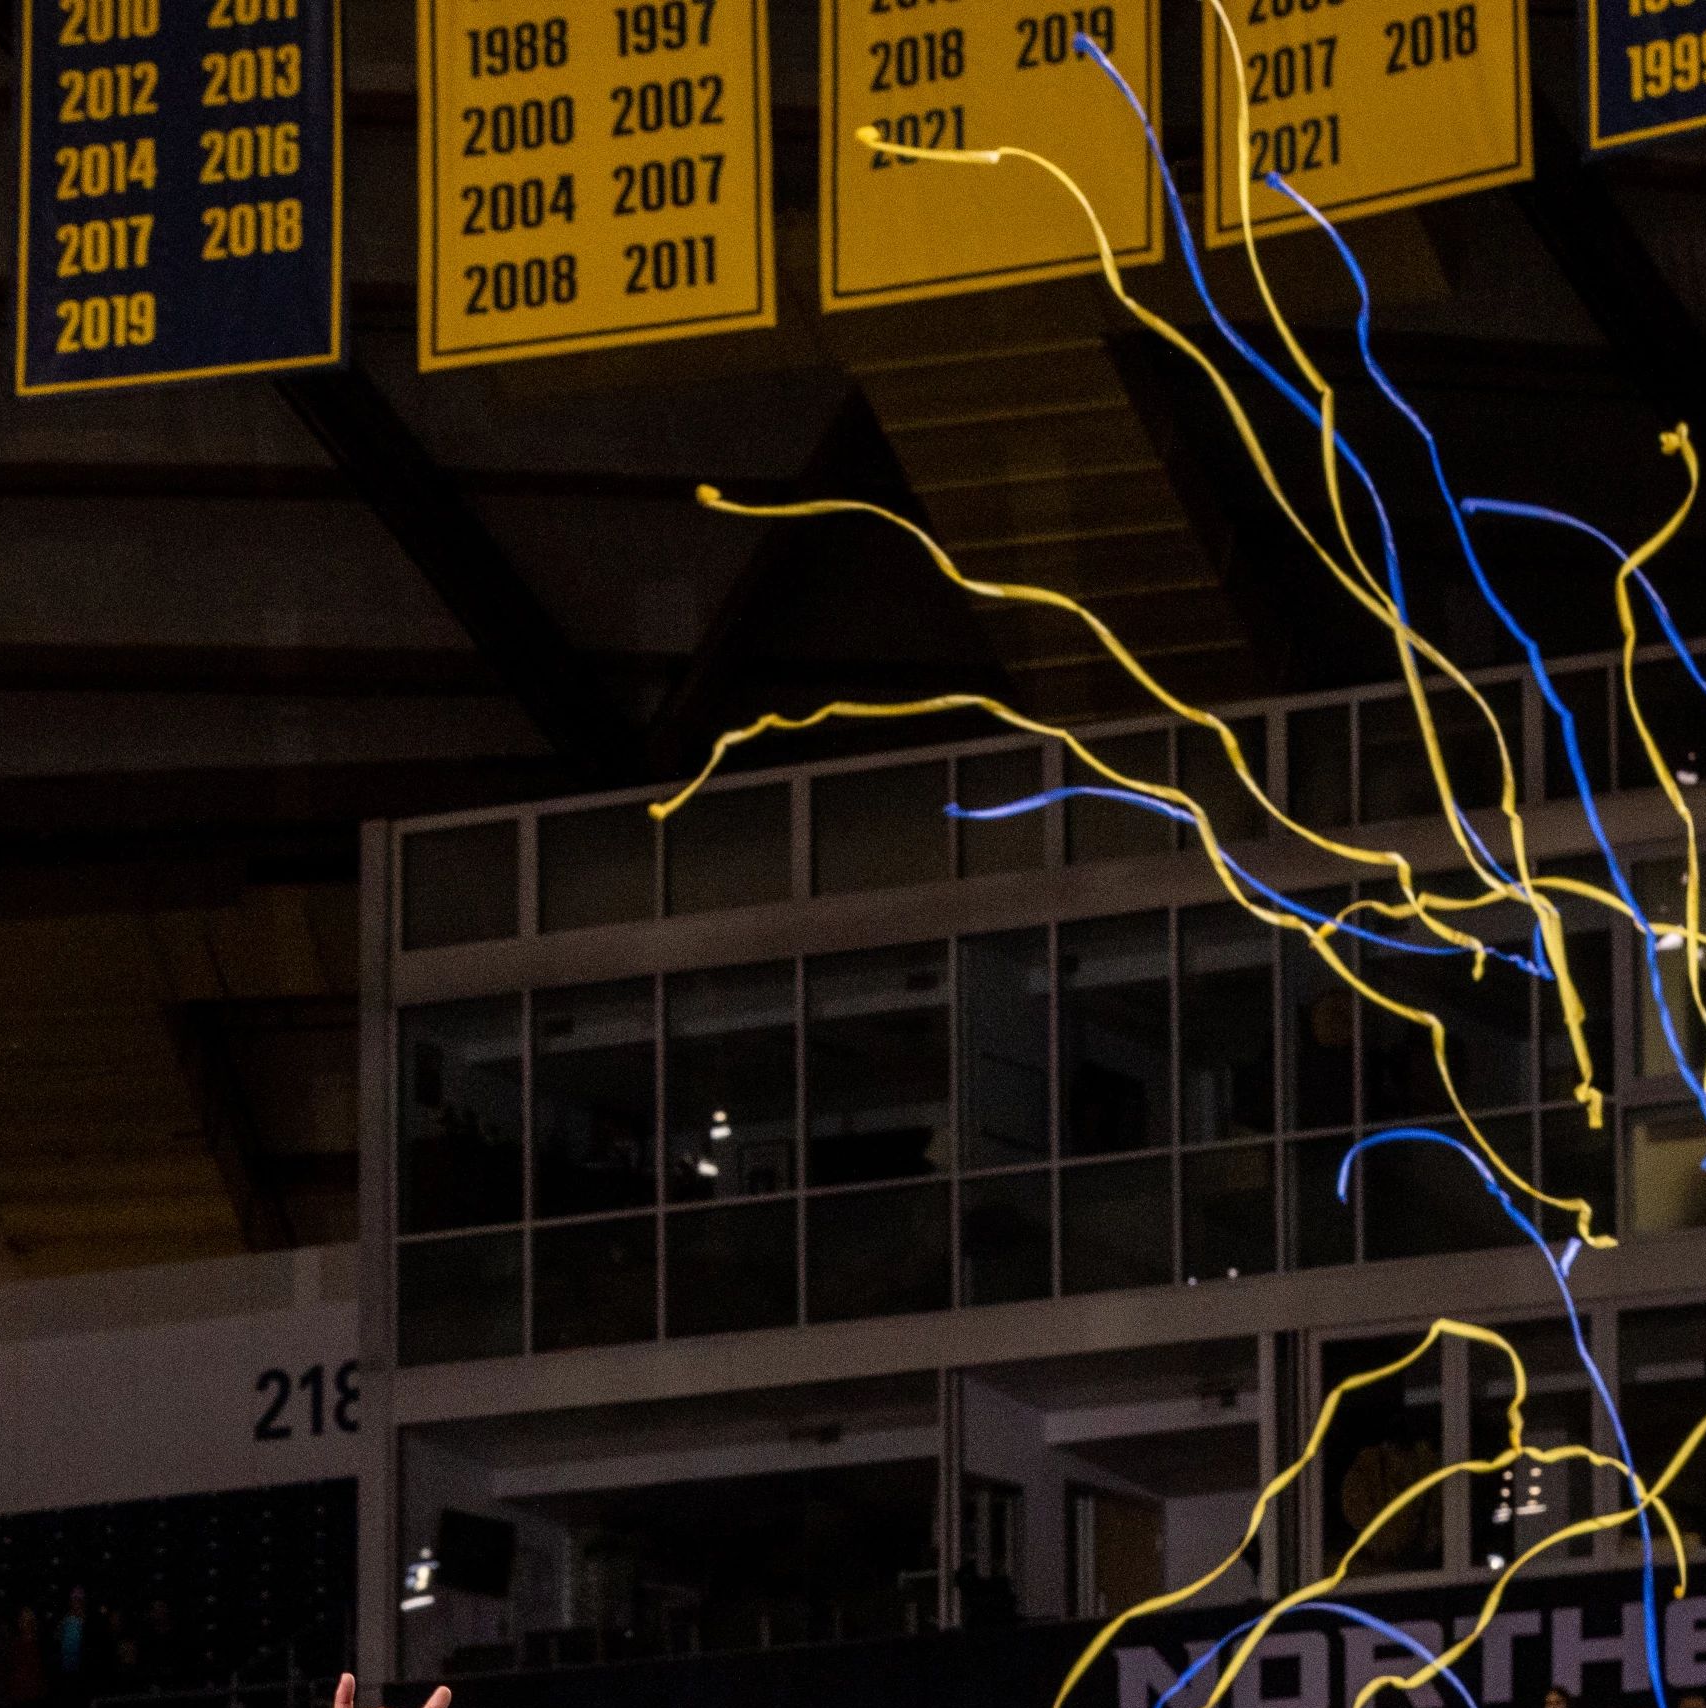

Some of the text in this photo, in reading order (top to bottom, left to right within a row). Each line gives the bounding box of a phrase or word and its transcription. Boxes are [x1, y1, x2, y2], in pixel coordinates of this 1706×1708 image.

[58, 0, 161, 47] 2010
[467, 0, 717, 80] 1988 1997
[869, 5, 1116, 93] 2018 2019
[1247, 3, 1478, 105] 2017 2018
[58, 42, 302, 124] 2012 2013
[462, 74, 725, 158] 2000 2002
[55, 120, 301, 202] 2014 2016
[1249, 113, 1341, 183] 2021
[461, 153, 726, 237] 2004 2007
[56, 198, 303, 279] 2017 2018
[463, 235, 717, 316] 2008 2011
[55, 291, 156, 355] 2019
